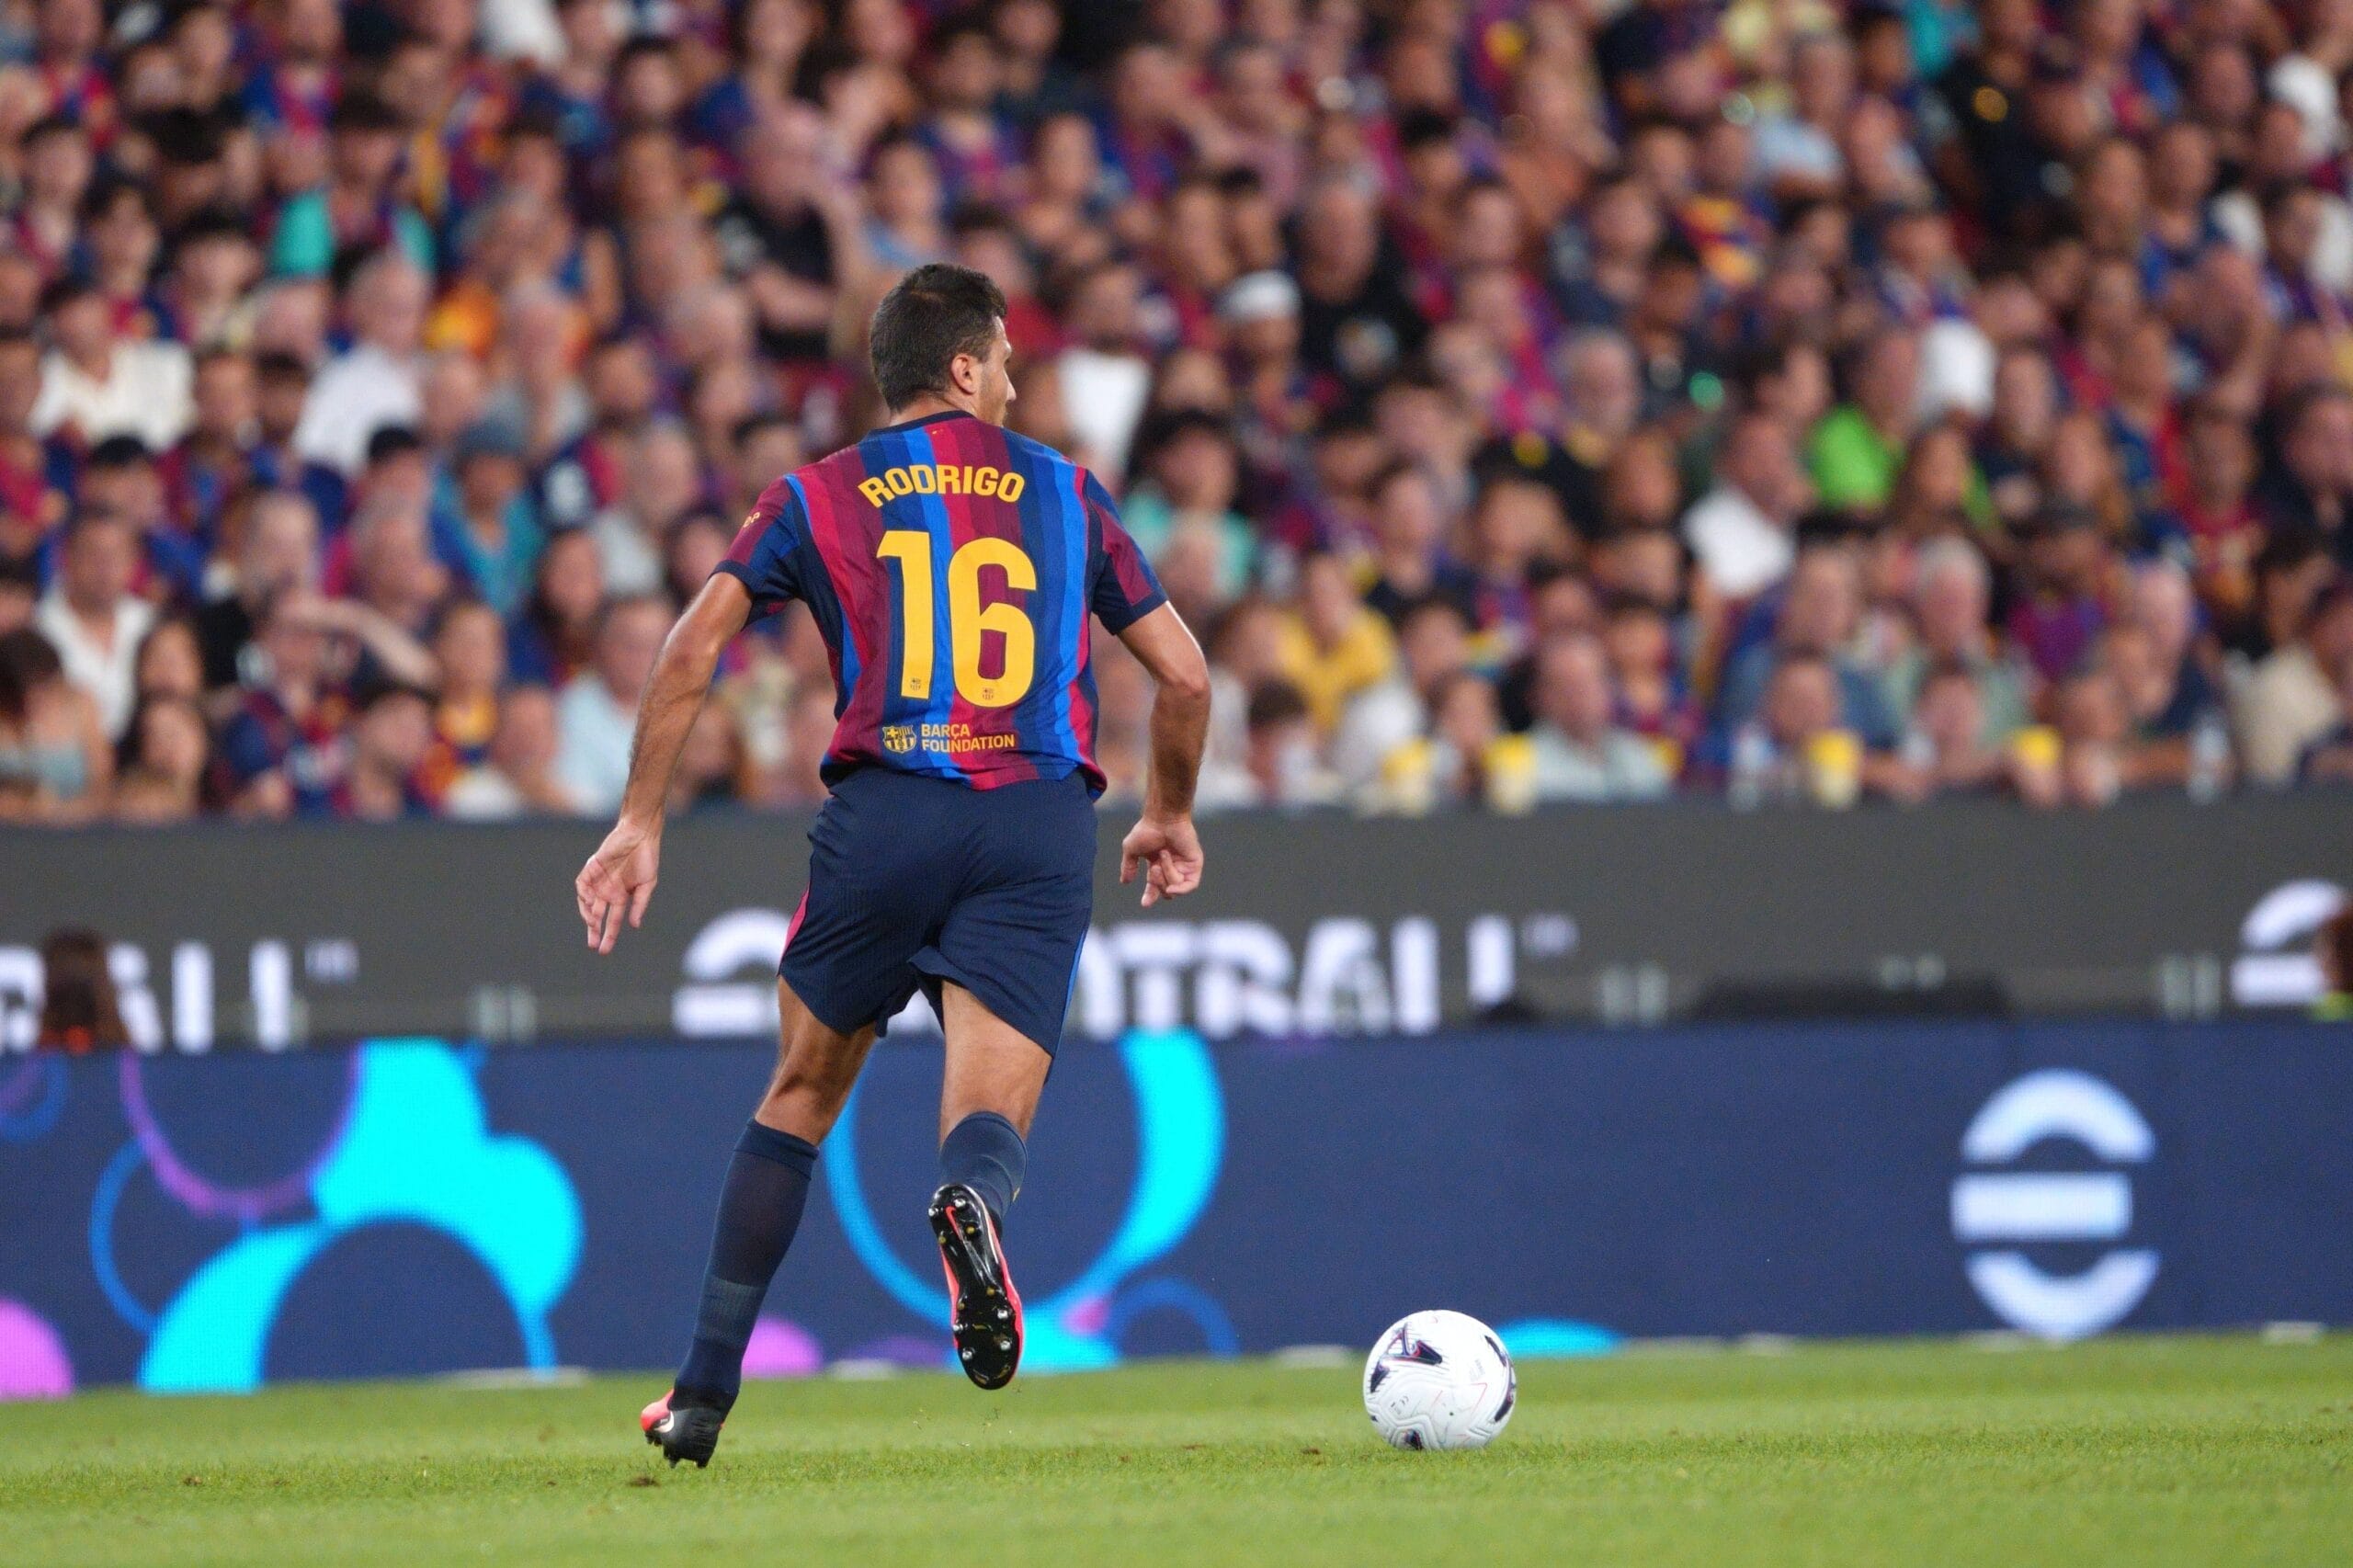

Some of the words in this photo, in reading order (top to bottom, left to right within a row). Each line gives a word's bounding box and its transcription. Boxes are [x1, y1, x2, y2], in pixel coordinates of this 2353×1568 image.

[858, 464, 1026, 508] RODRIGO
[876, 529, 1037, 708] 16
[921, 723, 971, 739] BARÇA
[921, 734, 1015, 753] FOUNDATION
